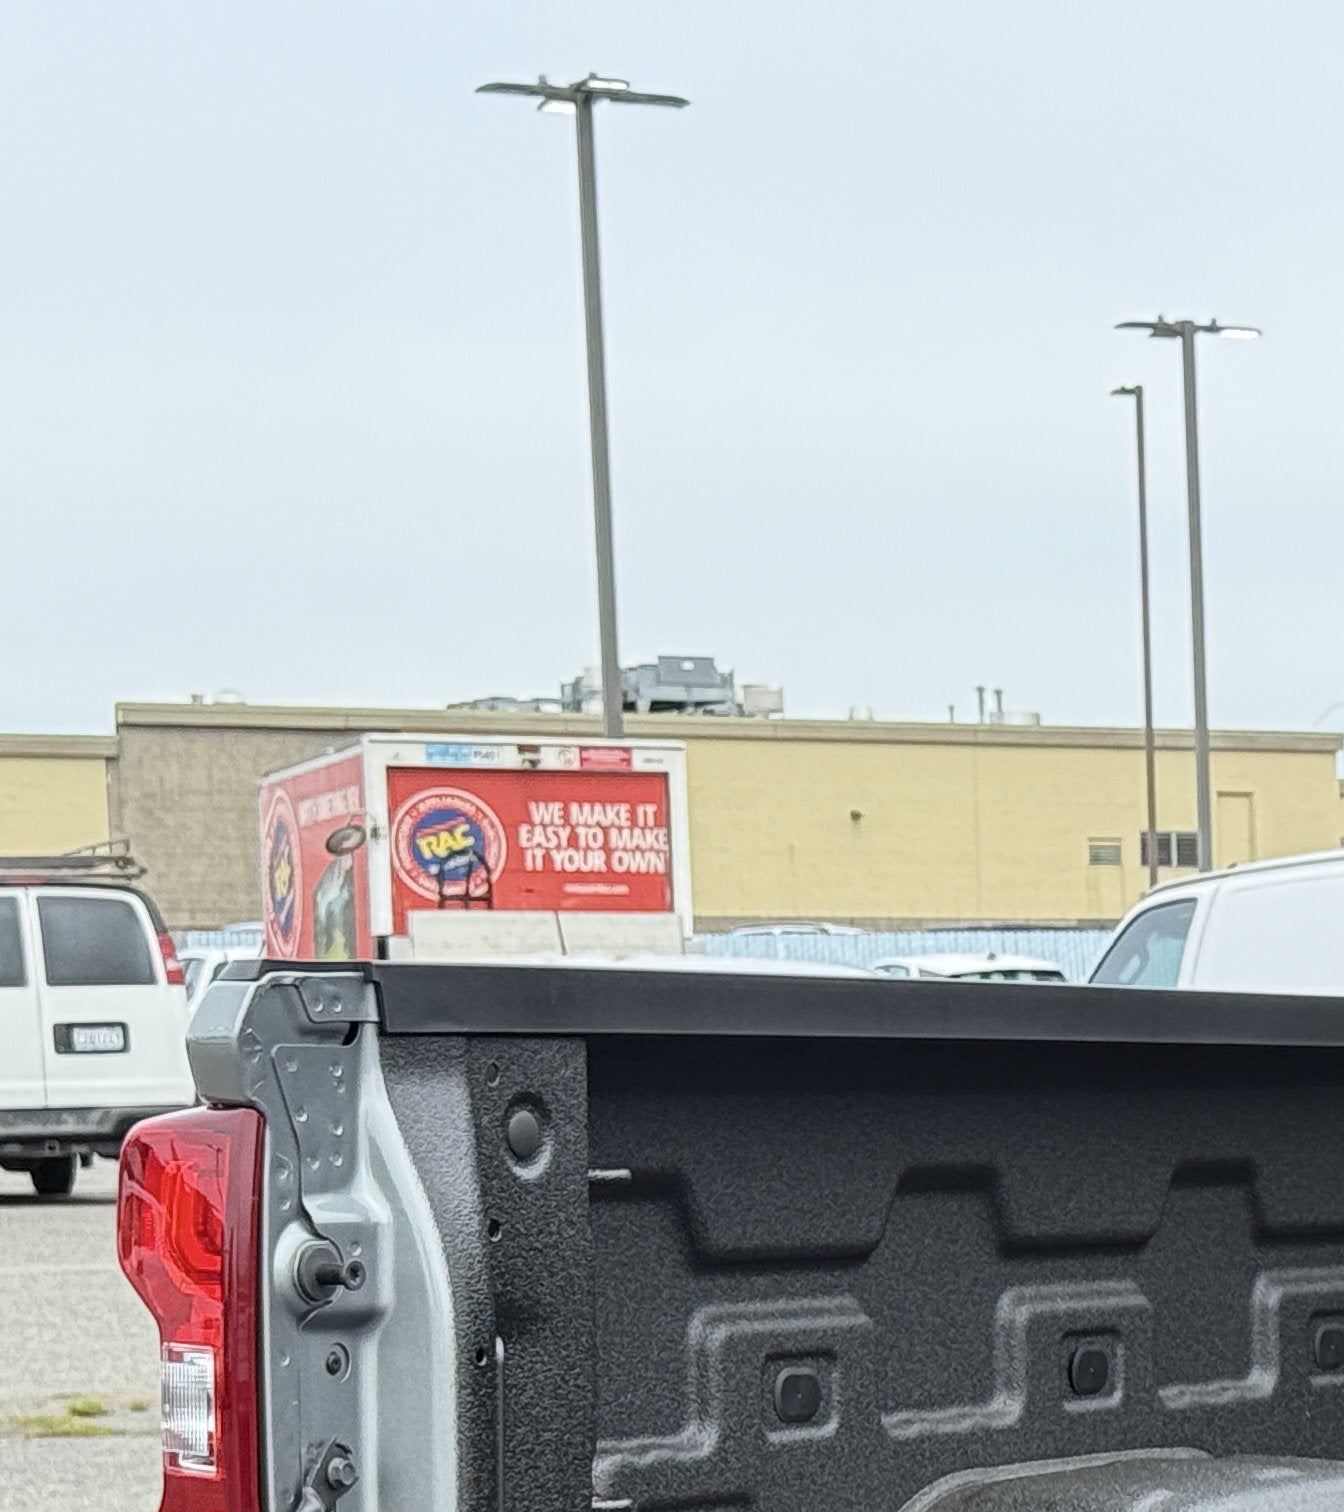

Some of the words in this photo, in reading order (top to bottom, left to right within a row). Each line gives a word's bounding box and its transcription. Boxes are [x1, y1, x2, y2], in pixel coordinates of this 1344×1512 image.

[528, 801, 565, 825] WE
[568, 802, 631, 827] MAKE
[636, 803, 657, 827] IT
[416, 823, 475, 860] RAC
[518, 823, 571, 848] EASY
[575, 826, 605, 849] TO
[609, 827, 668, 850] MAKE
[524, 847, 546, 872] IT
[550, 848, 607, 872] YOUR
[611, 850, 666, 873] OWN
